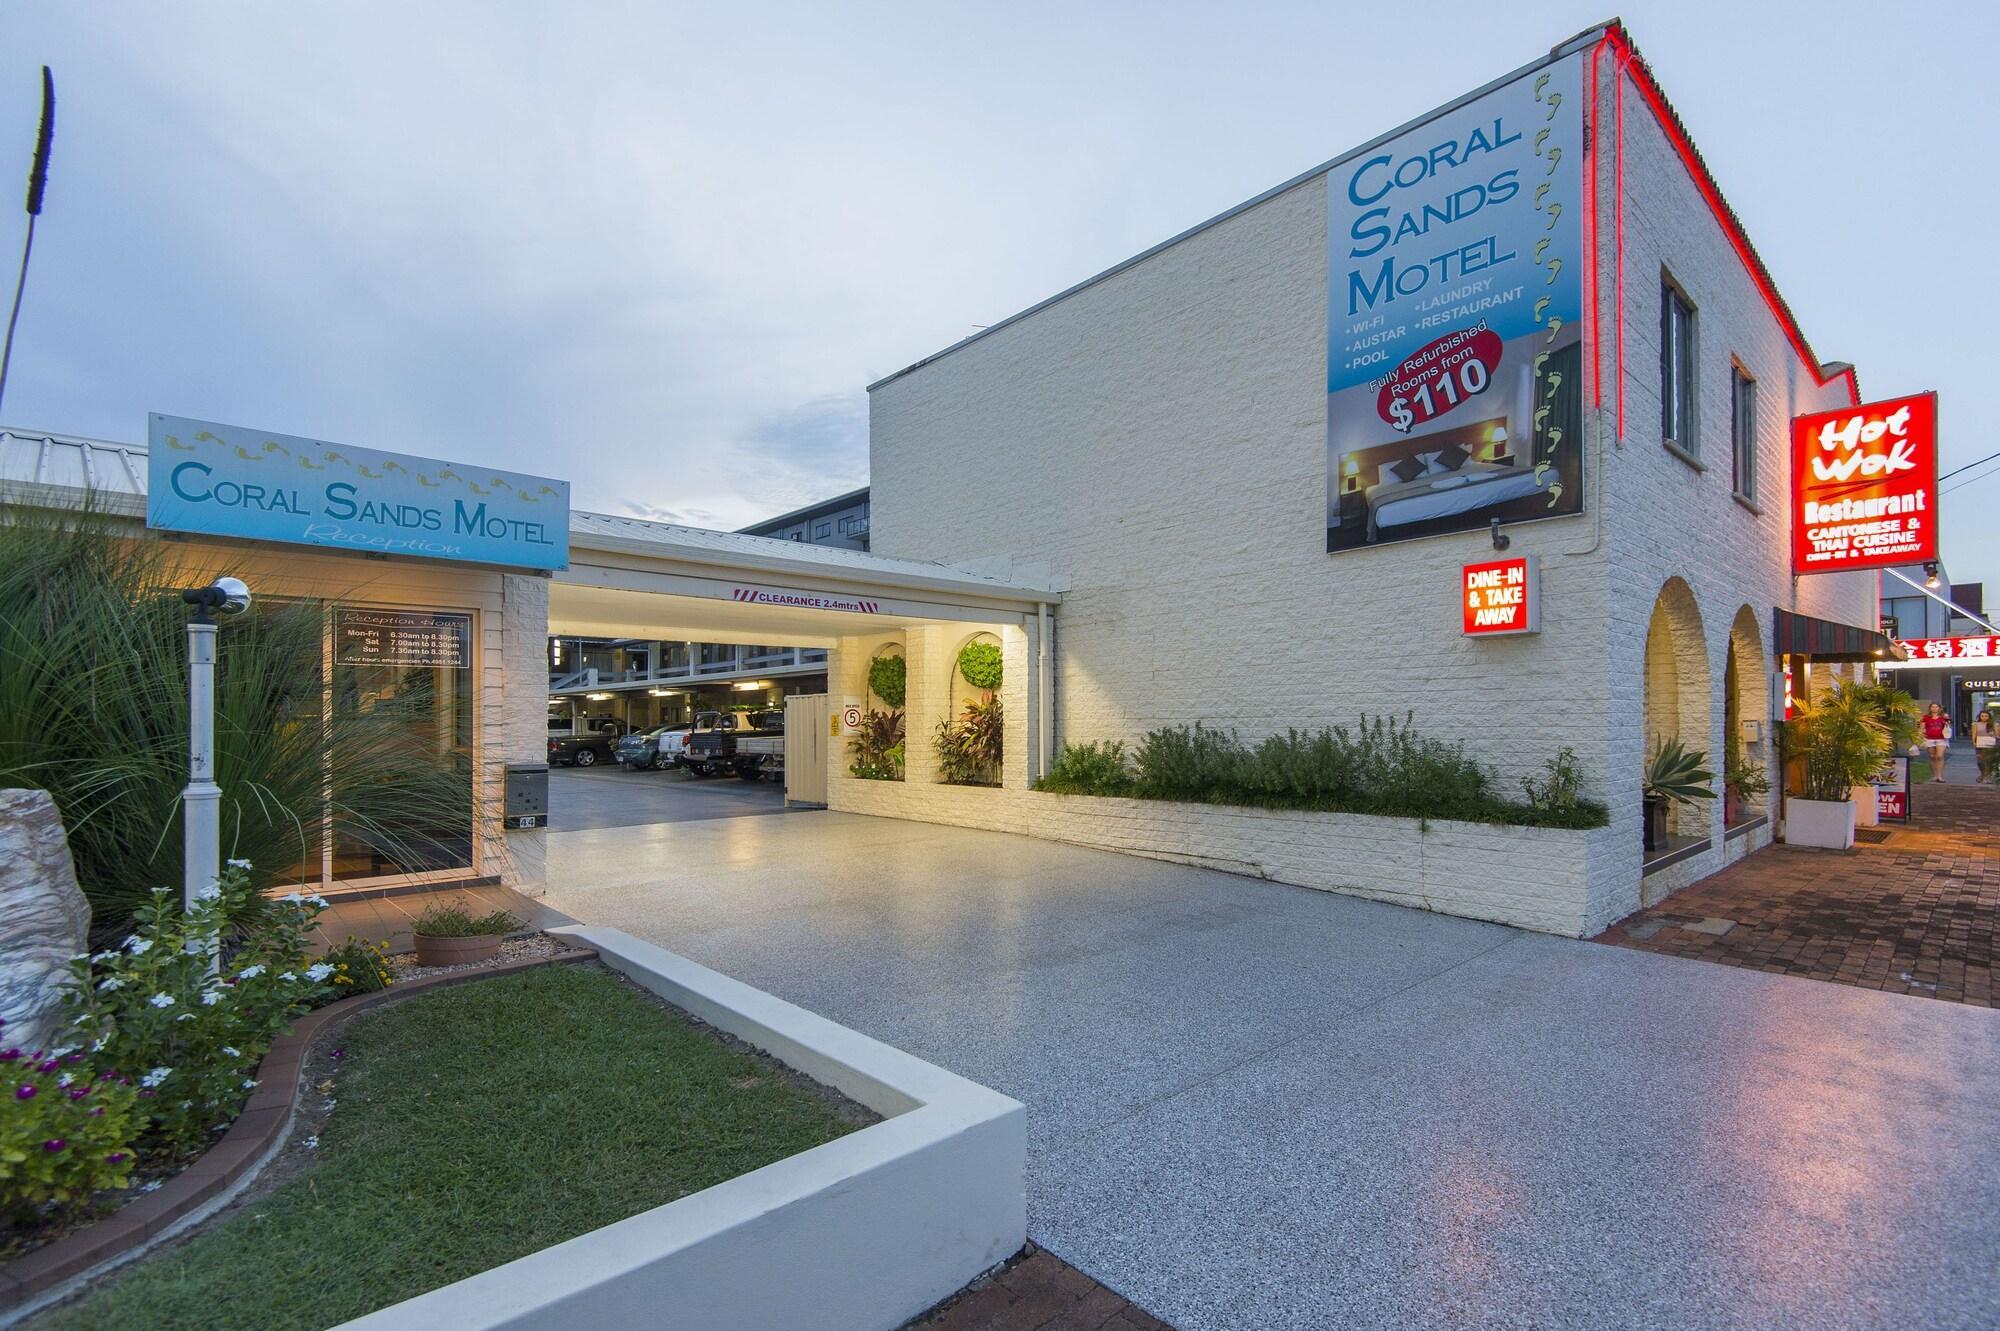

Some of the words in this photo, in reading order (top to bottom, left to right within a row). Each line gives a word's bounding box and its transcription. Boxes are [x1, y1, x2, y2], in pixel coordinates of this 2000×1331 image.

[1348, 118, 1522, 206] CORAL
[1349, 169, 1520, 259] SANDS
[1347, 236, 1516, 316] MOTEL
[1421, 278, 1493, 312] LAUNDRY
[1421, 286, 1525, 329] RESTAURANT
[1352, 315, 1385, 335] WI-FI
[1352, 326, 1406, 352] AUSTAR
[1353, 350, 1390, 369] POOL
[1368, 370, 1399, 393] Fully
[1404, 318, 1487, 374] Refurbished
[1391, 365, 1439, 397] Rooms
[1441, 346, 1474, 370] from
[1389, 358, 1490, 433] $110
[1818, 405, 1911, 451] Hot
[170, 461, 311, 517] CORAL
[323, 482, 442, 531] SANDS
[453, 499, 554, 546] MOTEL
[1804, 489, 1926, 525] Restaurant
[303, 523, 462, 554] Reception
[1806, 519, 1901, 541] CANTONESE
[1907, 517, 1921, 529] &
[1812, 540, 1849, 552] THAI
[1852, 530, 1916, 548] CUISINE
[1806, 551, 1847, 562] DINE-IN
[1849, 549, 1859, 558] &
[1862, 543, 1922, 556] TAKEAWAY
[1467, 567, 1524, 589] DINE-IN
[759, 593, 821, 607] CLEARANCE
[823, 600, 859, 611] 2.4mtrs
[1468, 590, 1481, 608] &
[1485, 586, 1523, 606] TAKE
[344, 611, 415, 625] Reception
[1474, 606, 1517, 627] AWAY
[347, 629, 379, 638] Mon-Fri
[431, 634, 460, 642] 8.30pm
[431, 641, 460, 649] 8.30pm
[849, 712, 856, 724] 5
[520, 817, 535, 826] 44
